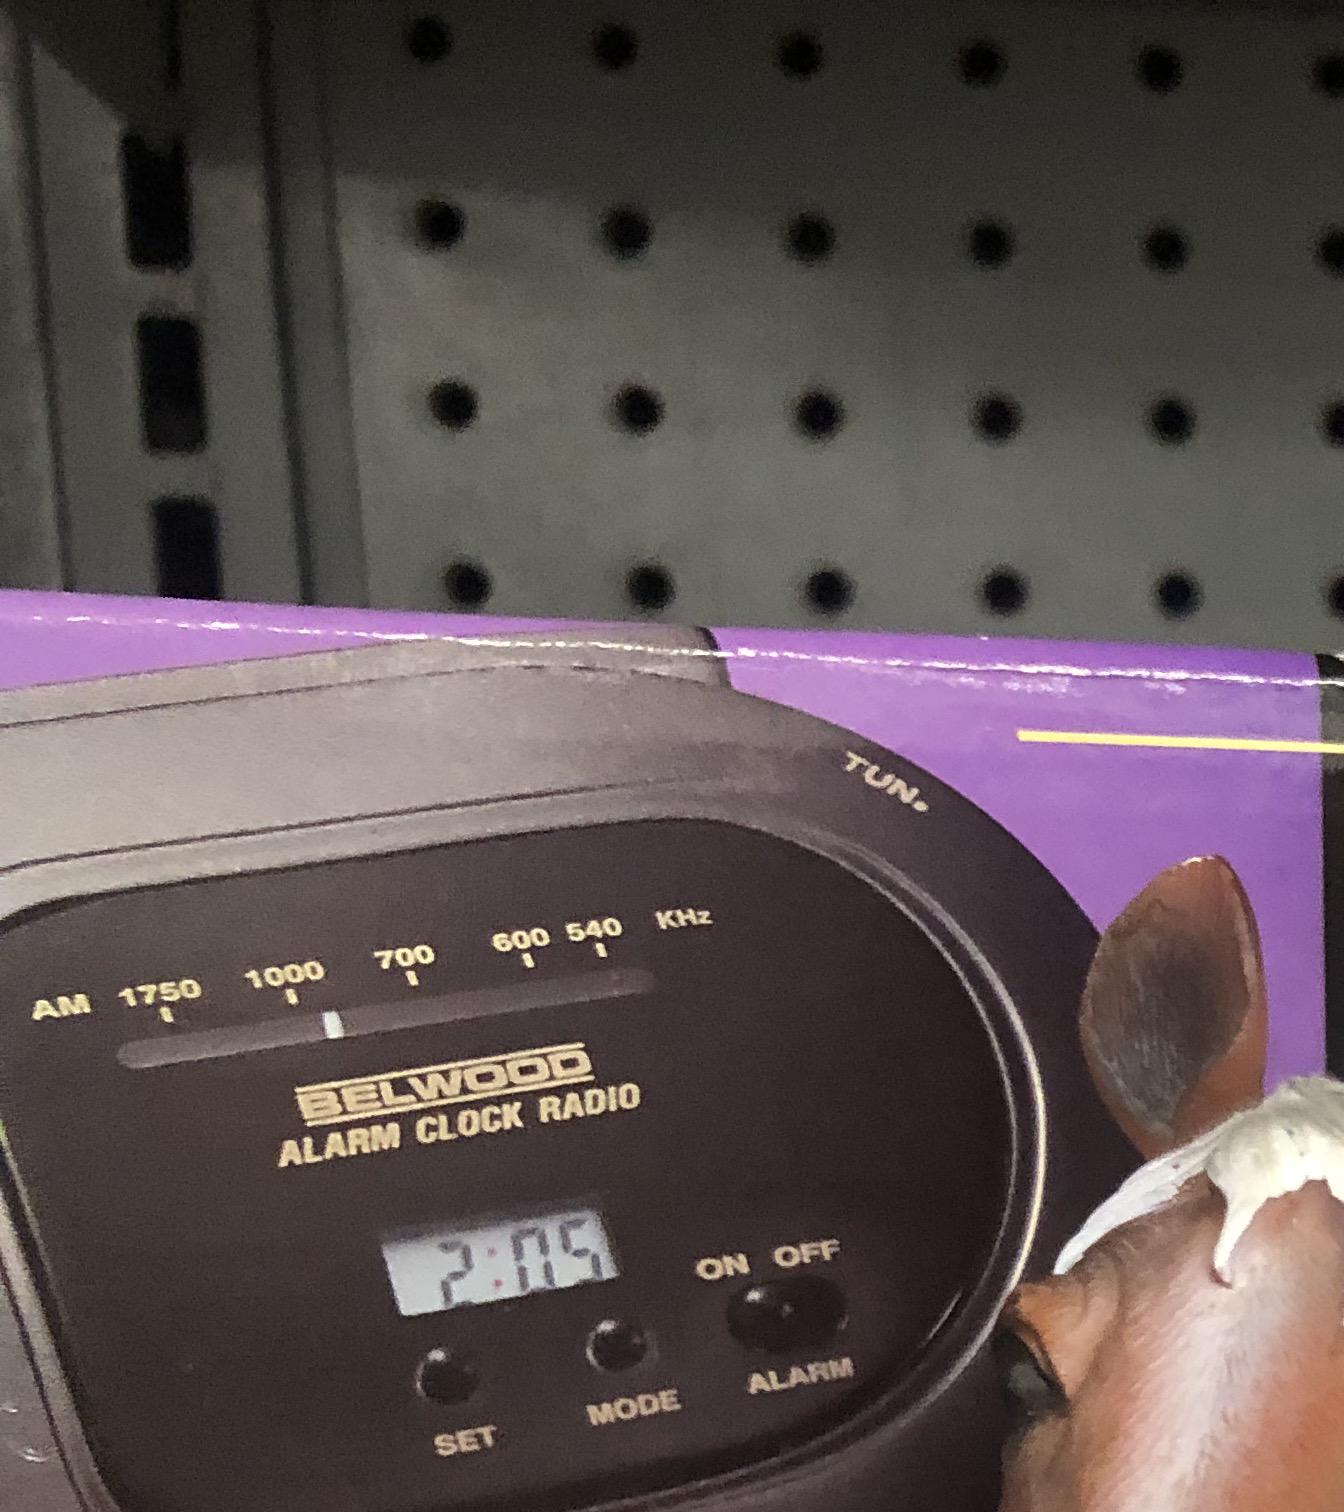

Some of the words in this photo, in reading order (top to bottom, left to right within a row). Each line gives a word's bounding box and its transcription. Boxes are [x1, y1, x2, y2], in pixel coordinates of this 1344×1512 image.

[845, 750, 929, 812] TUN.
[32, 993, 92, 1021] AM
[117, 978, 202, 1007] 1750
[244, 960, 326, 989] 1000
[374, 944, 436, 970] 700
[491, 927, 551, 953] 600
[564, 917, 623, 942] 540
[655, 907, 713, 930] KHz
[296, 1049, 593, 1121] BELWOOD
[278, 1121, 401, 1168] ALARM
[415, 1101, 525, 1145] CLOCK
[537, 1082, 642, 1124] RADIO
[437, 1217, 604, 1309] 2:05
[696, 1252, 752, 1281] ON
[772, 1238, 841, 1269] OFF
[746, 1356, 855, 1395] ALARM
[585, 1388, 683, 1428] MODE
[433, 1424, 498, 1458] SET
